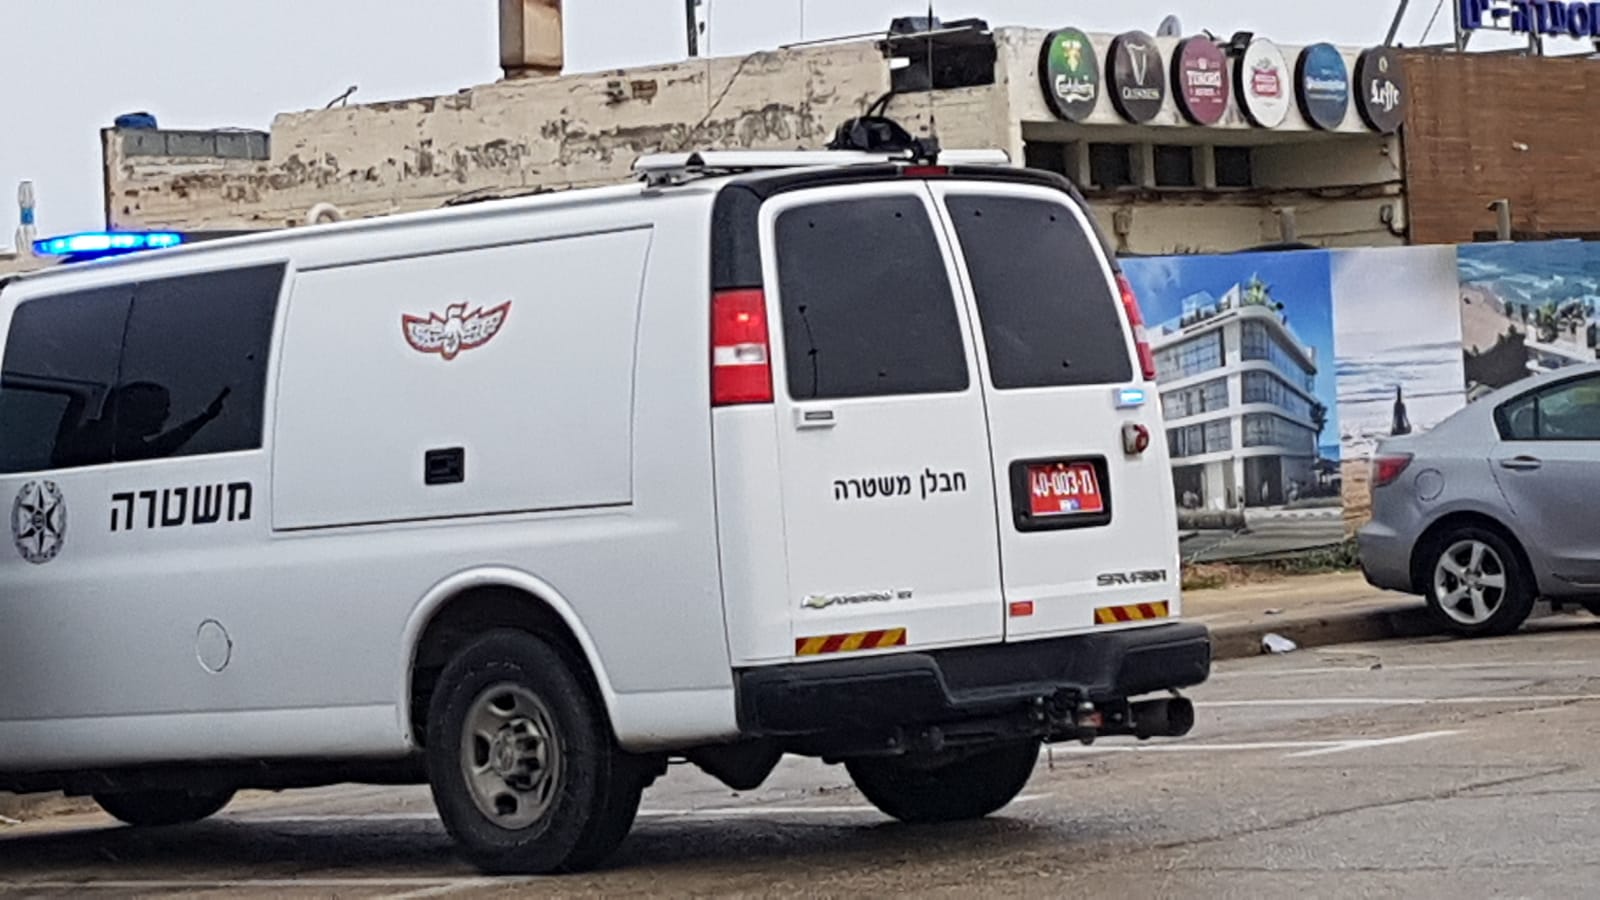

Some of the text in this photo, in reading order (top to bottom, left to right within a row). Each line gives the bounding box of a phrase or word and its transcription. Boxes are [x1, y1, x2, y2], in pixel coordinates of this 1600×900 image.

[1055, 74, 1095, 103] Carlsberg
[1370, 79, 1400, 113] Leffe
[833, 467, 967, 500] חבלן משטרה
[110, 481, 253, 532] משטרה
